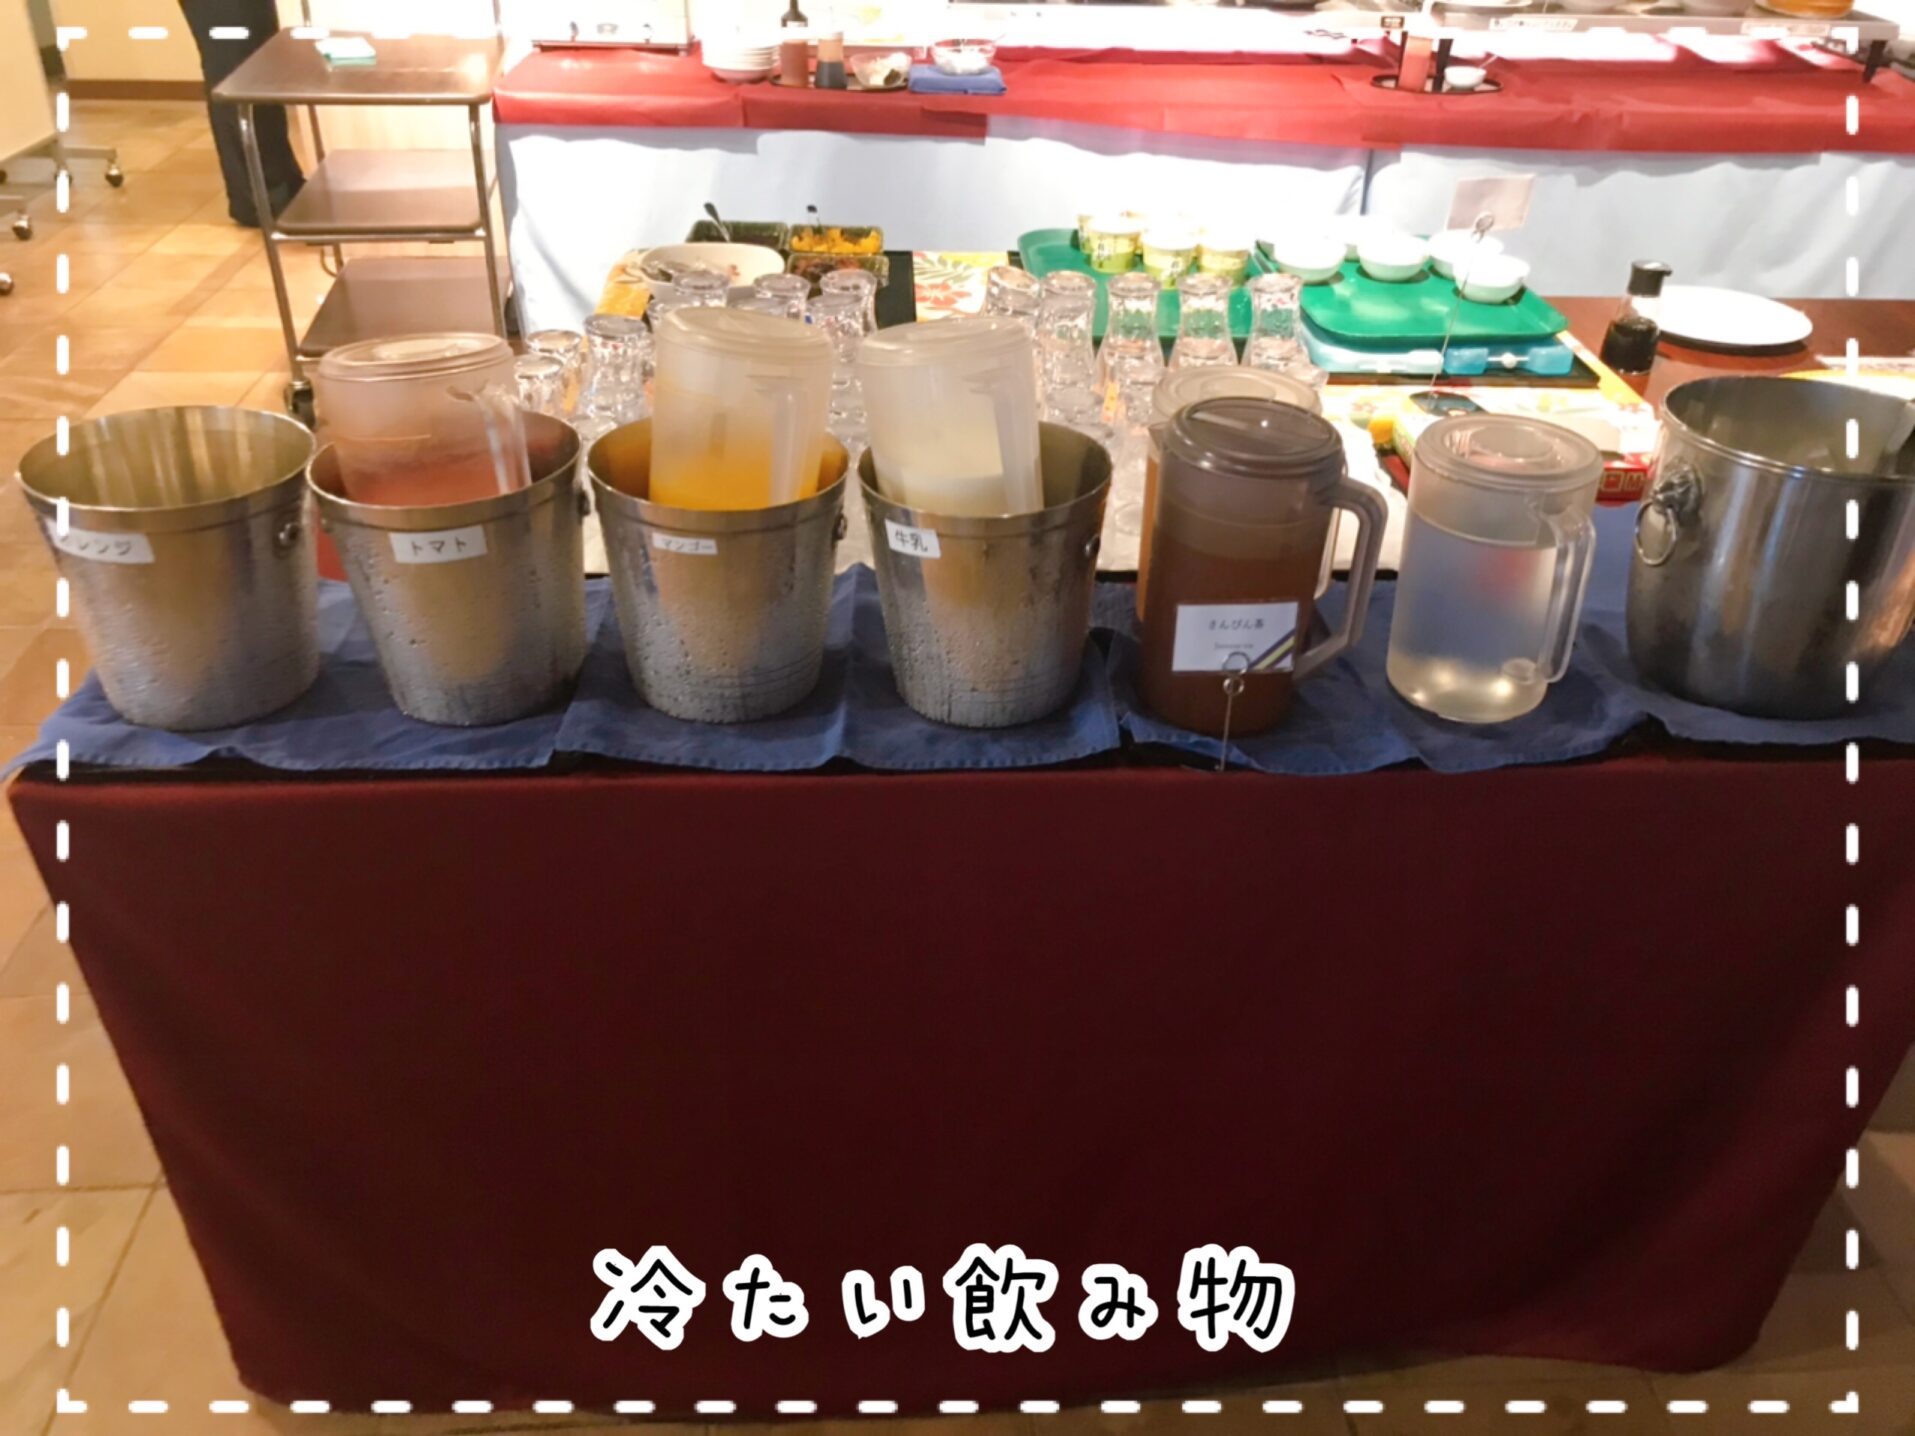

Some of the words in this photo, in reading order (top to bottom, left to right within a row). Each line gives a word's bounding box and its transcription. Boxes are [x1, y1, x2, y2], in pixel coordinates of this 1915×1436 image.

[411, 536, 466, 556] トマト
[662, 538, 713, 552] マンゴー
[895, 528, 928, 552] 牛乳
[1208, 617, 1265, 631] さんぴん茶
